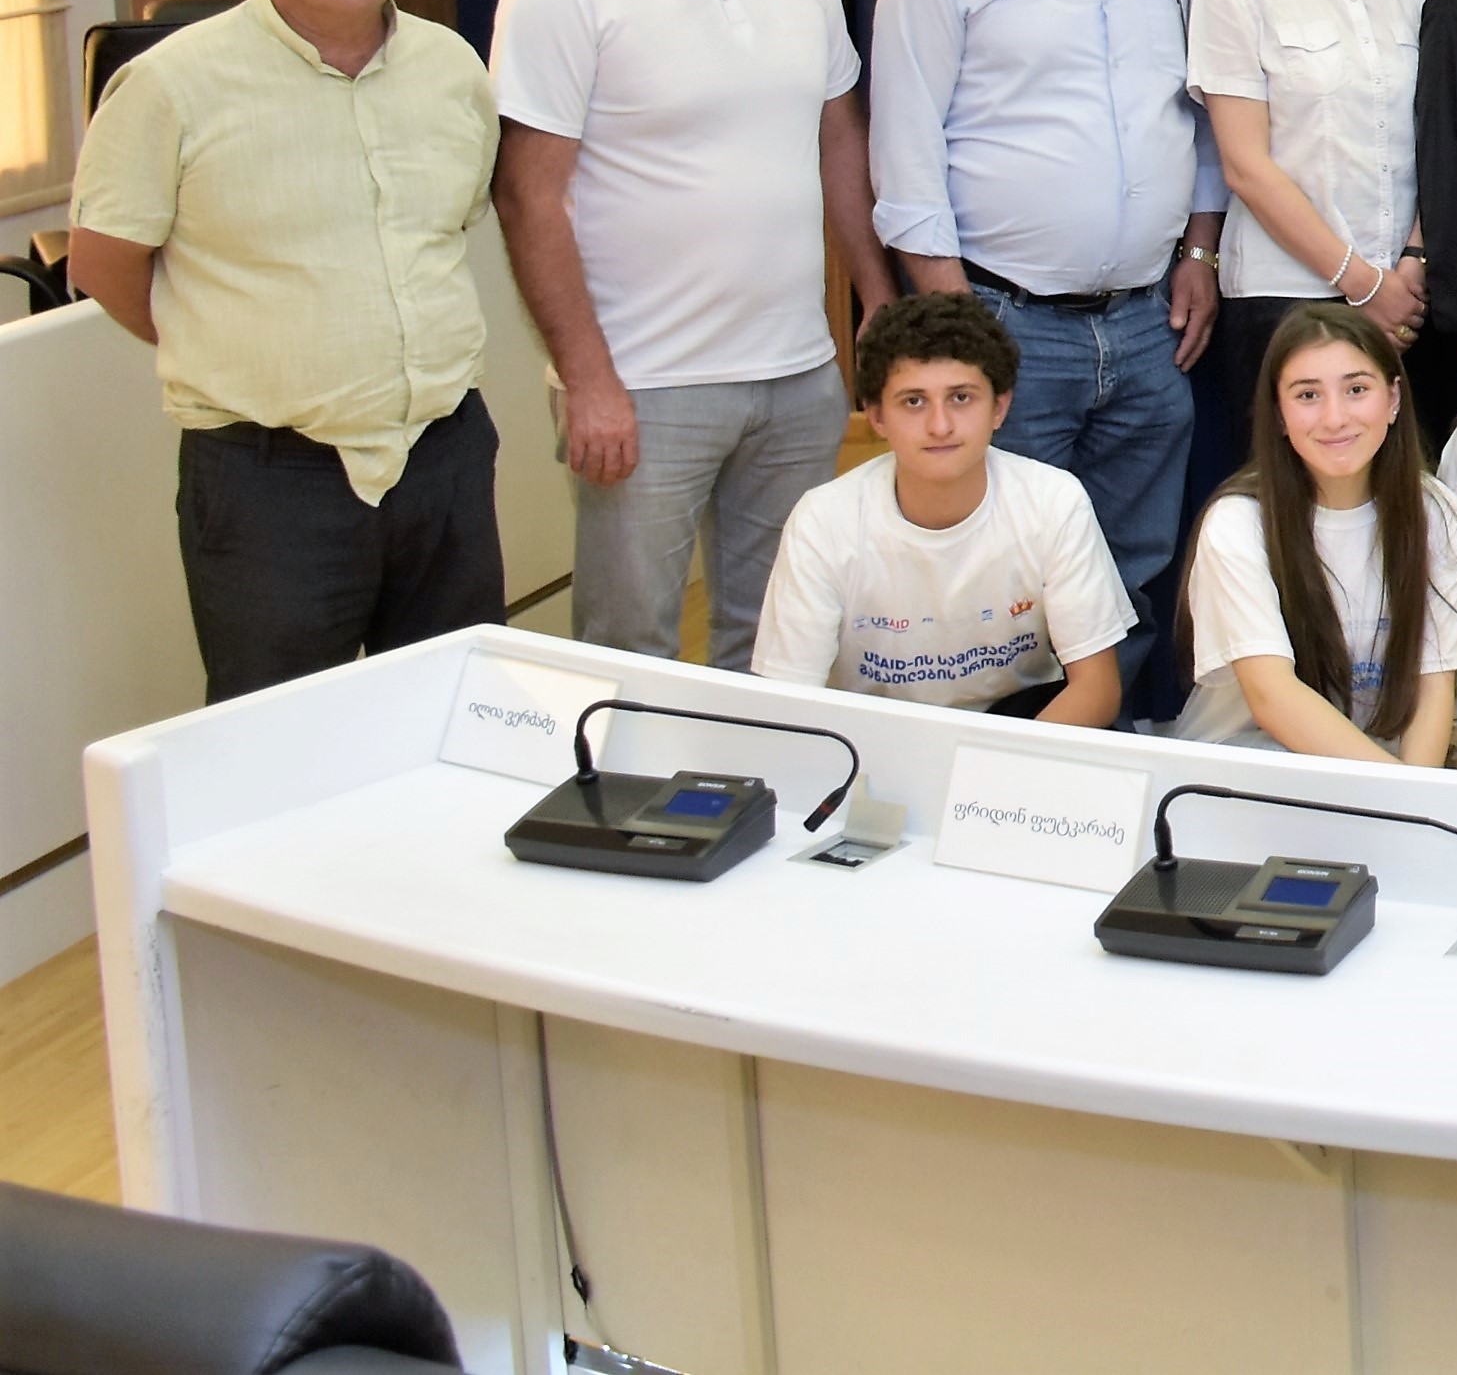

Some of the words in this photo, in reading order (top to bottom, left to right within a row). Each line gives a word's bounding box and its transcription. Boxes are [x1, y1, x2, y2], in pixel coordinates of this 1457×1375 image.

[871, 617, 910, 630] USAID
[864, 651, 934, 671] USAID-ის
[859, 664, 957, 685] განათლების
[954, 800, 1027, 827] ფრიდონ
[1030, 814, 1126, 846] ფუტკარაძე
